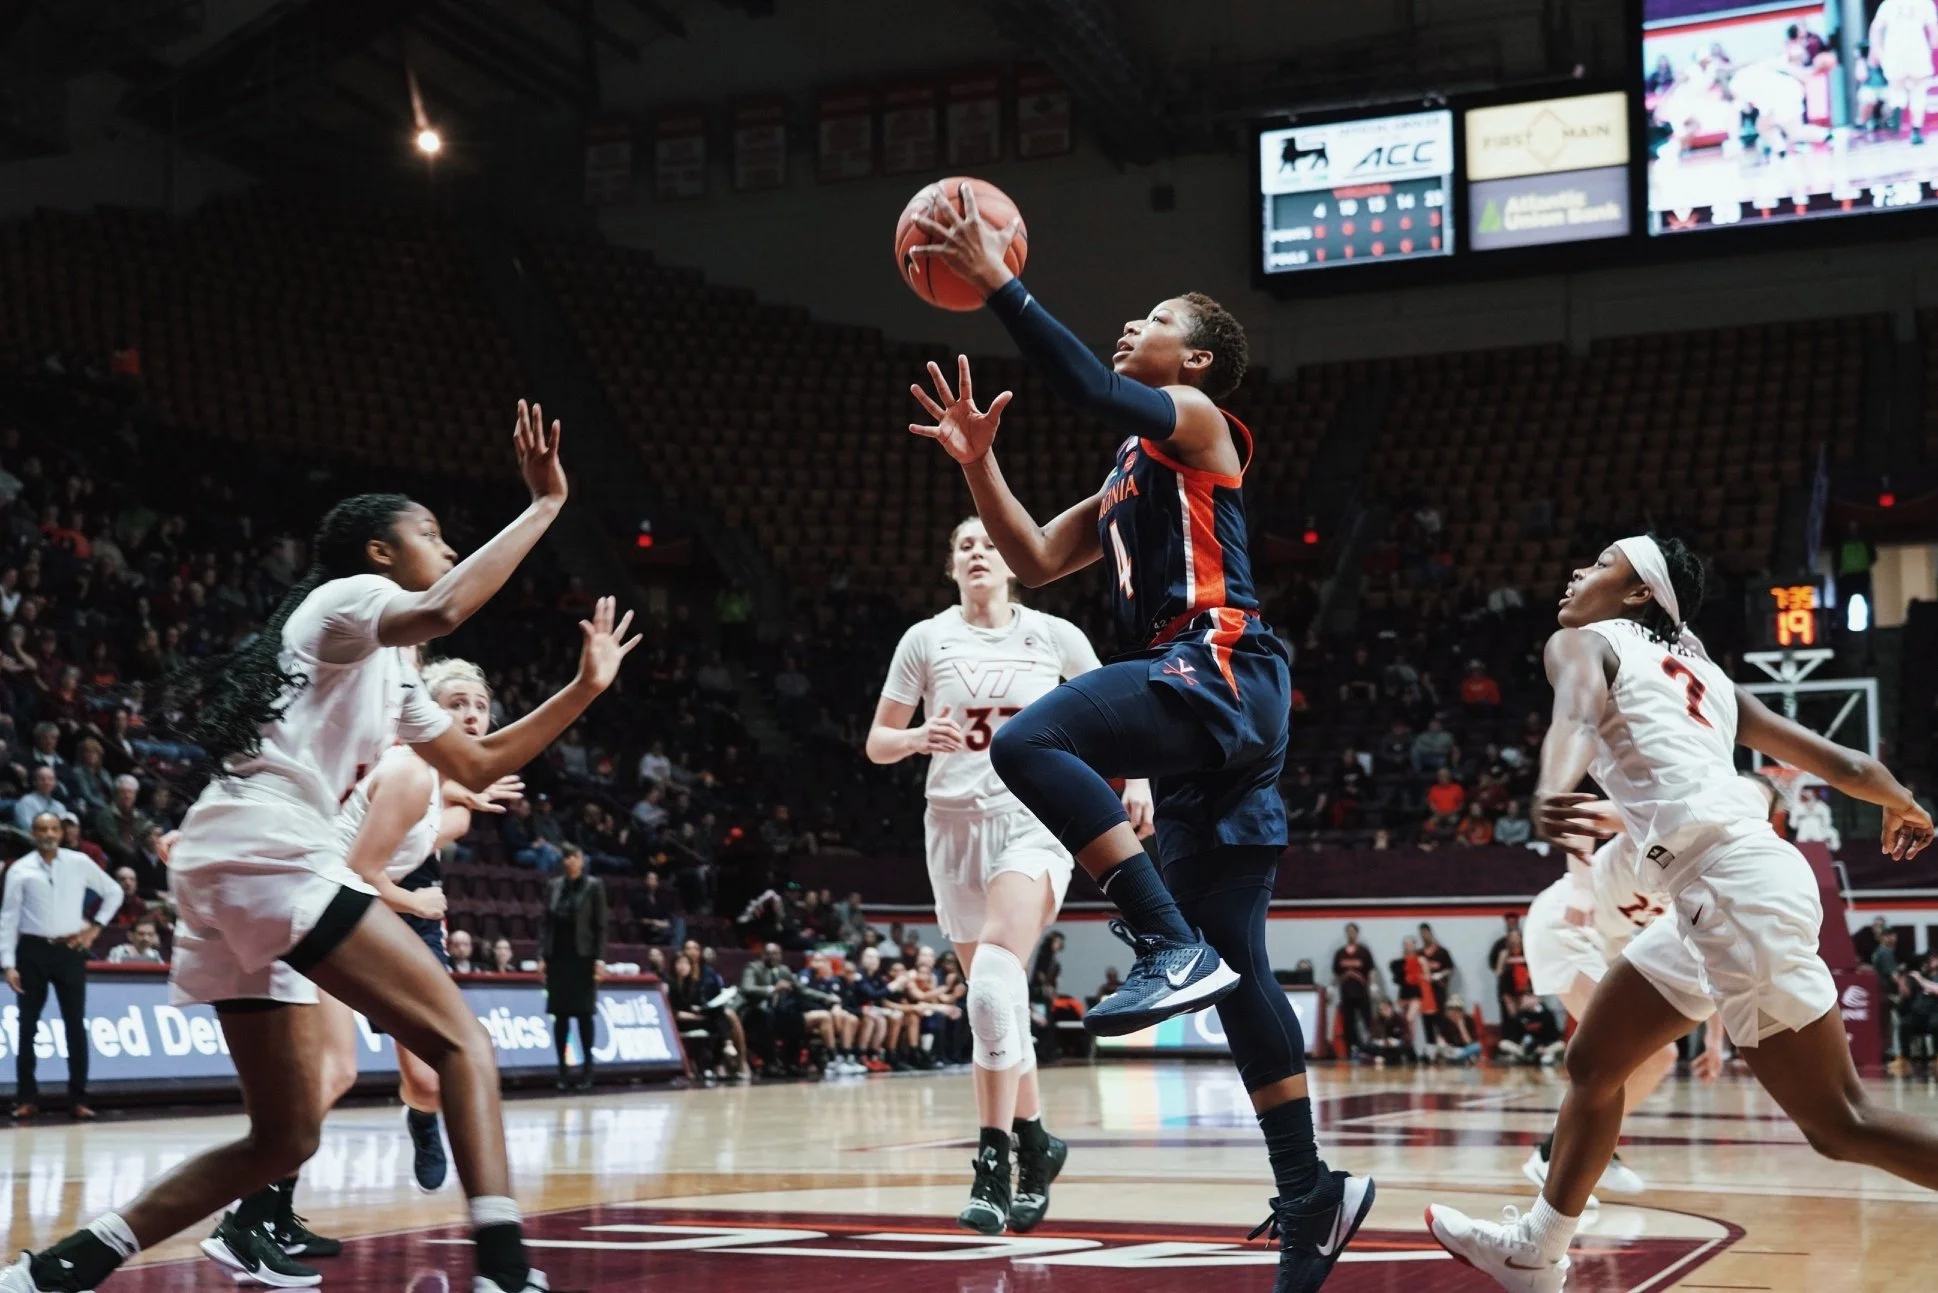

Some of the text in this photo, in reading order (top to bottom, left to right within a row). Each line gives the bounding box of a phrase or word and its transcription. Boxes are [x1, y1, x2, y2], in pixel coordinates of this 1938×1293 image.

[1562, 124, 1611, 139] MAIN
[1353, 140, 1435, 170] ACC
[1109, 520, 1134, 599] 4
[1776, 609, 1815, 646] 19
[952, 660, 1036, 699] VT
